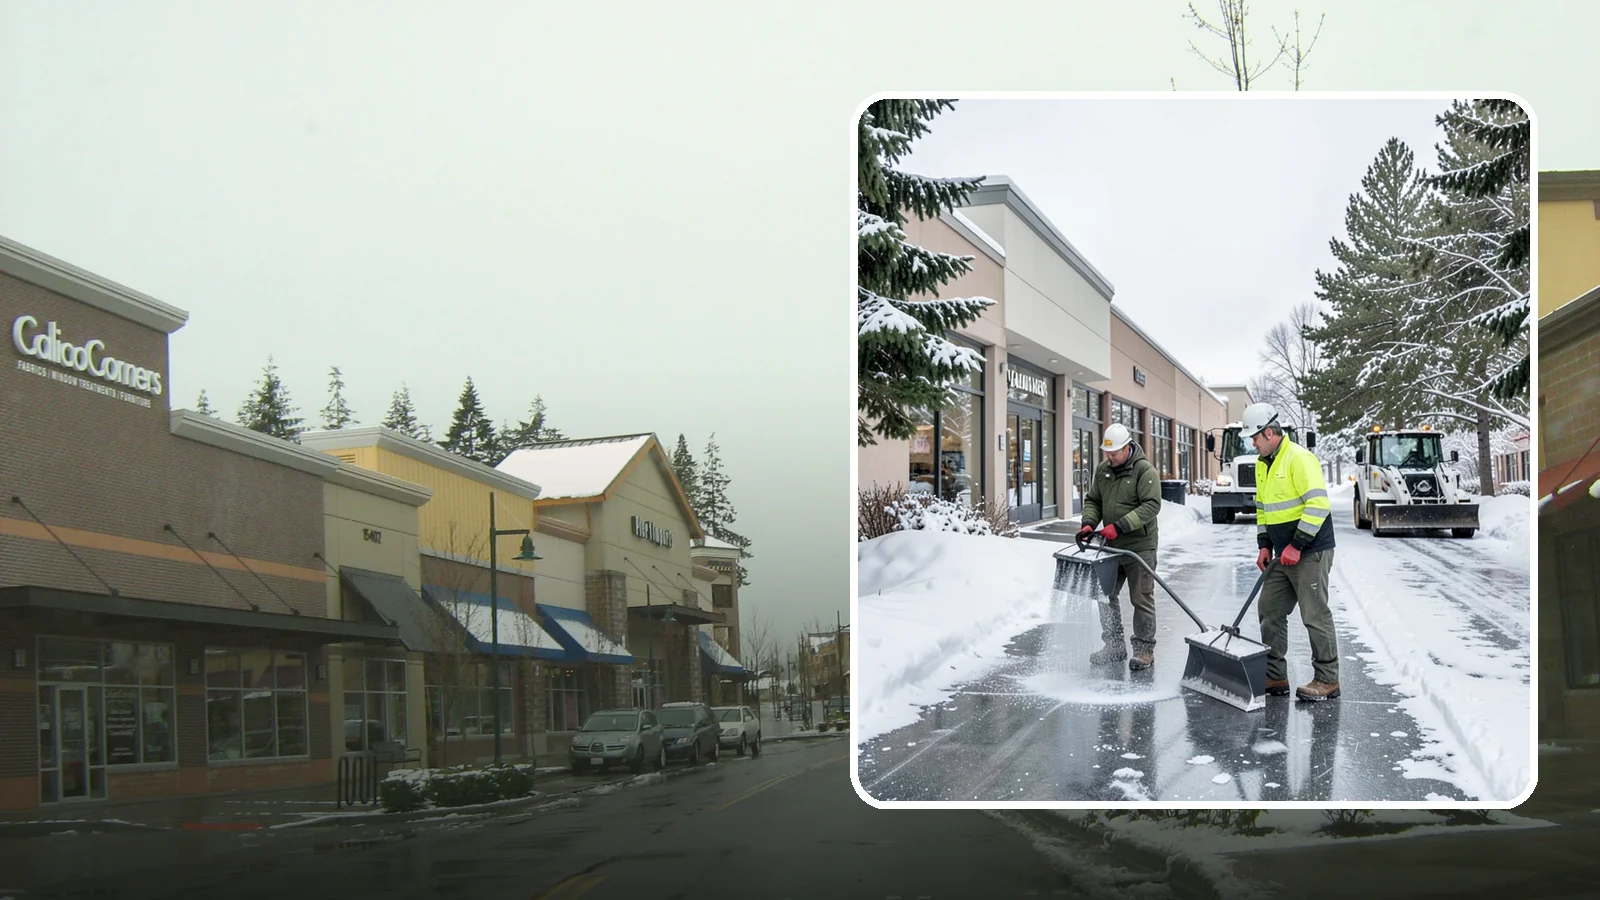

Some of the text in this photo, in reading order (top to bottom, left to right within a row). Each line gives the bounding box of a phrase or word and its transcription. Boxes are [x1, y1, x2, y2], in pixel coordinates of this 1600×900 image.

[17, 360, 47, 378] FABRICS
[51, 370, 78, 386] WINDOW
[78, 378, 116, 398] TREATMENTS
[120, 391, 151, 409] FURNITURE
